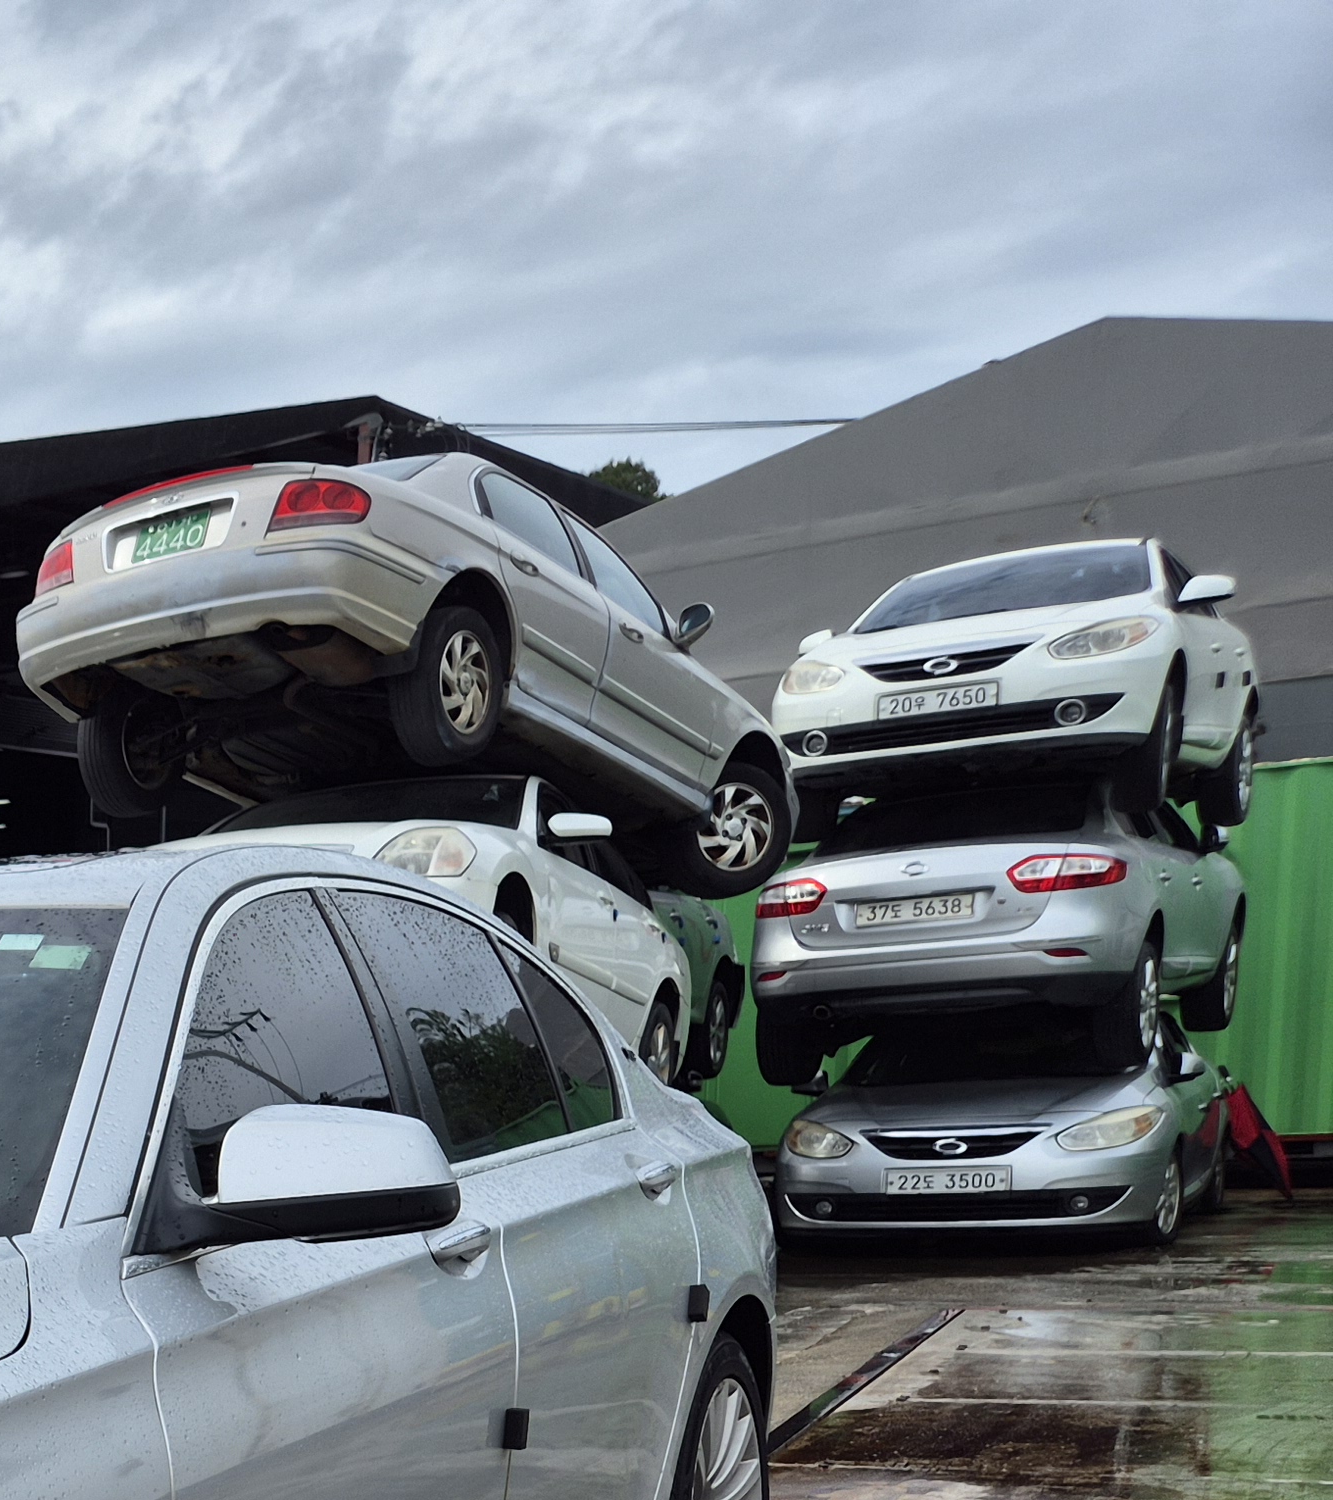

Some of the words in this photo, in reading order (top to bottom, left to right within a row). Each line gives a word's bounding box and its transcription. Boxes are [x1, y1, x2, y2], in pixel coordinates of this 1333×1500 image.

[136, 524, 203, 558] 4440
[889, 696, 925, 715] 20우
[936, 687, 986, 709] 7650
[866, 904, 901, 921] 37도
[912, 898, 961, 917] 5638
[945, 1172, 996, 1189] 3500
